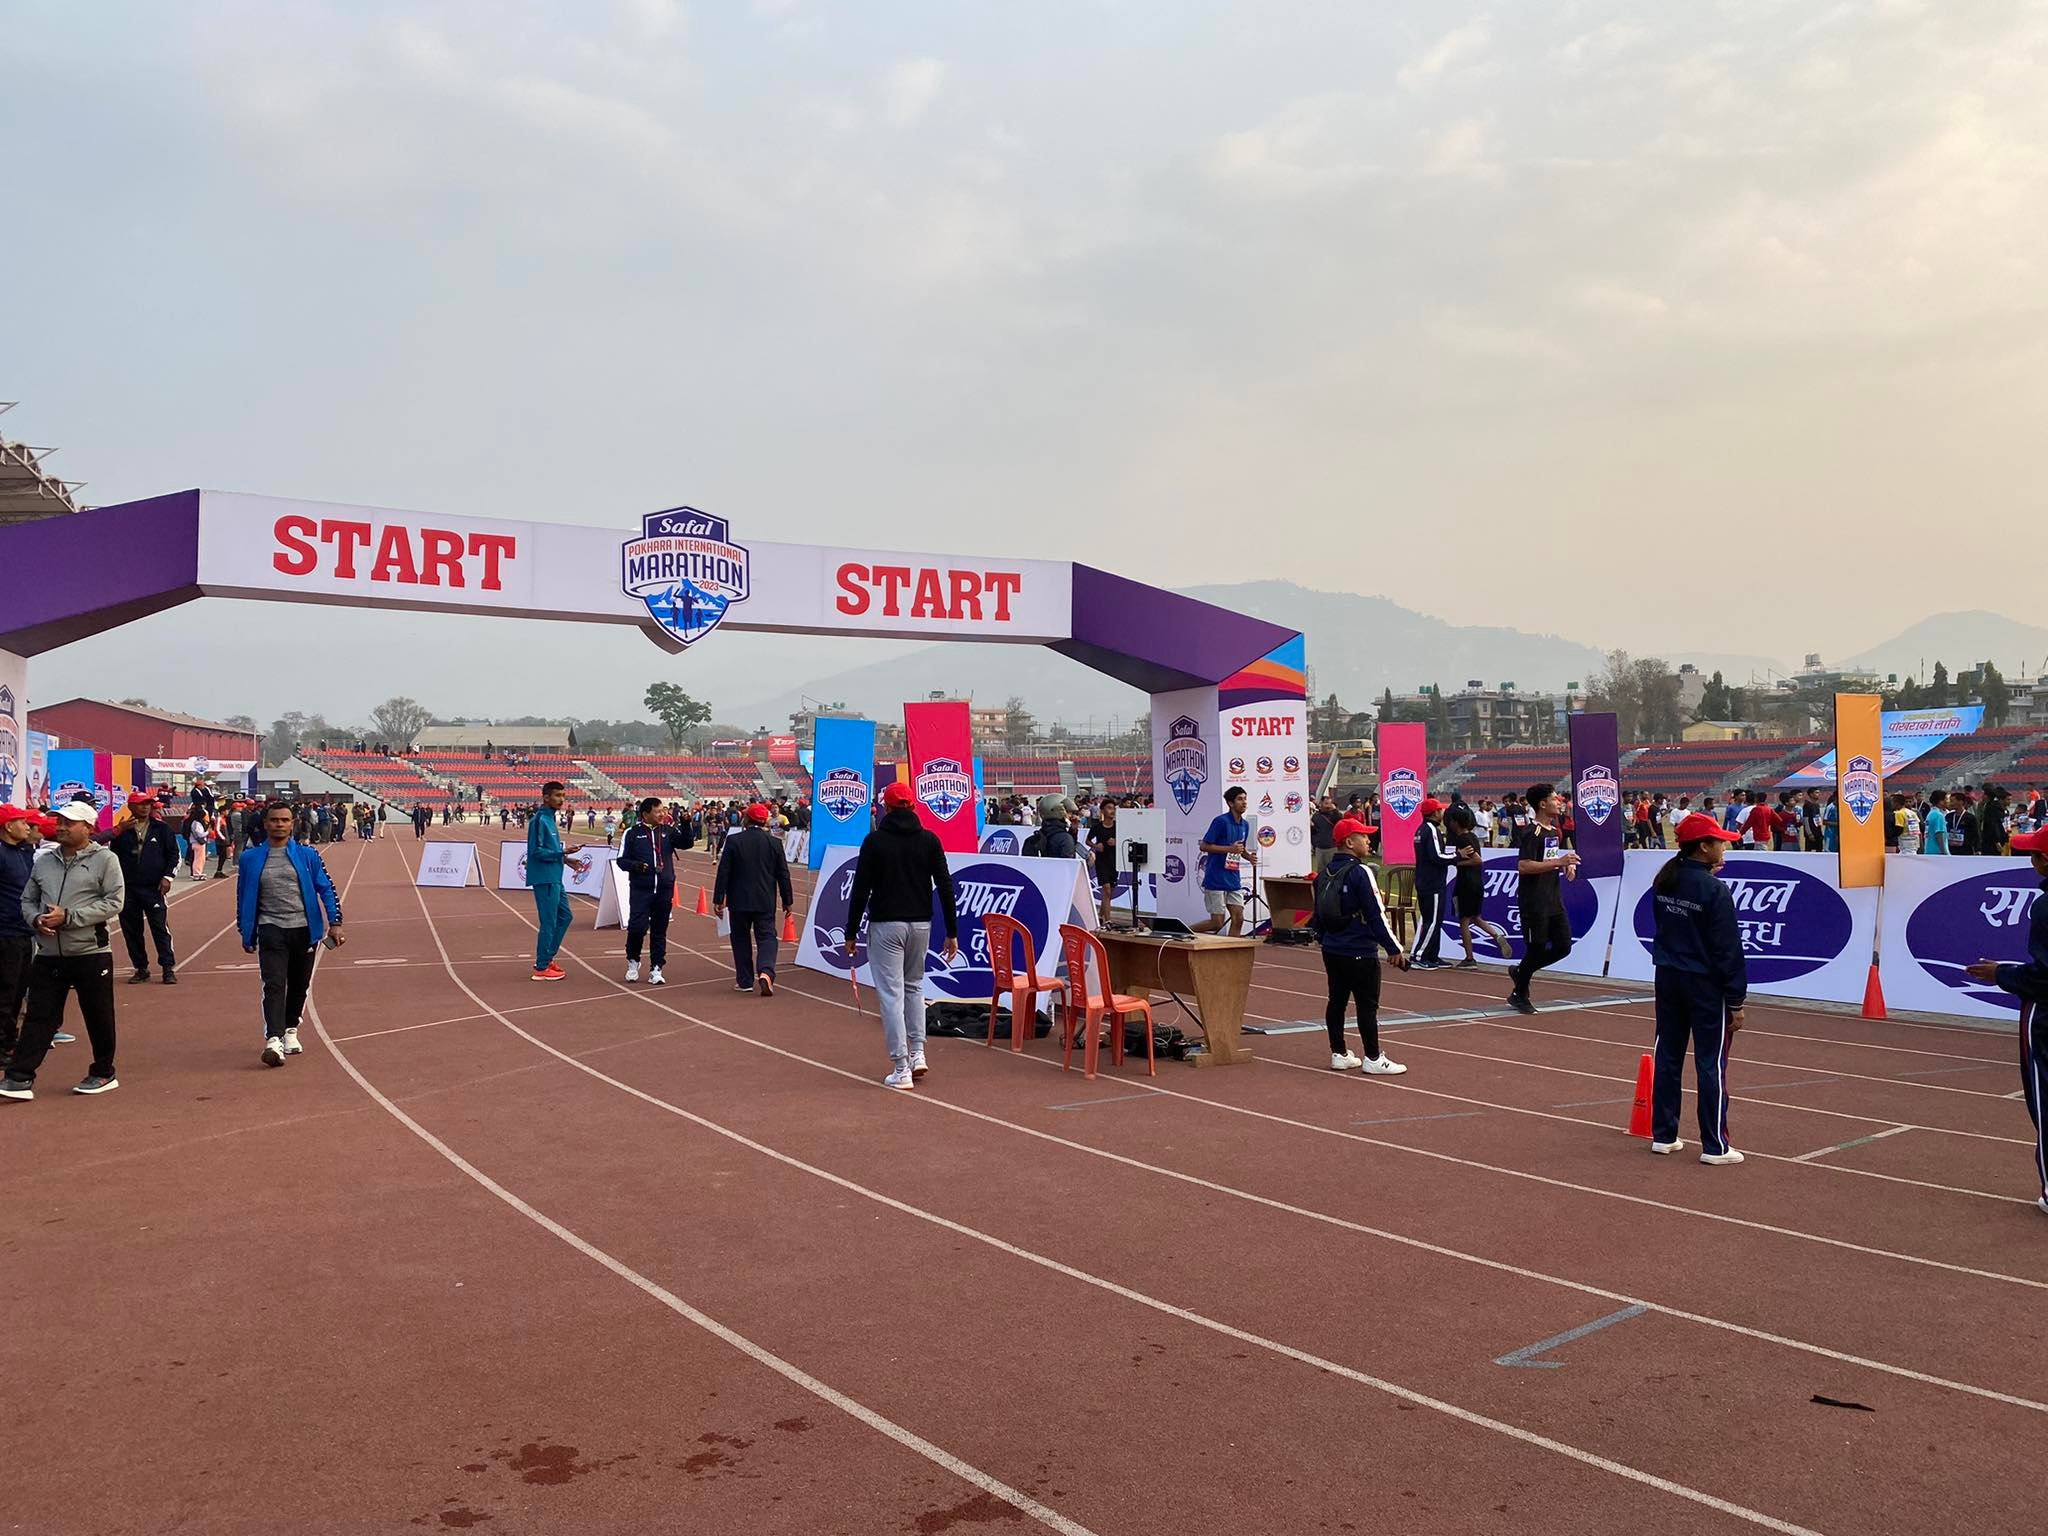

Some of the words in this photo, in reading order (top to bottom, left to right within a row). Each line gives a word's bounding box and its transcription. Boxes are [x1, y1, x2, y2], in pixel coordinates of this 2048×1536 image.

[659, 518, 714, 536] Safal
[273, 515, 516, 591] START
[628, 539, 673, 558] POKHARA
[674, 539, 743, 564] INTERNATIONAL
[629, 552, 743, 590] MARATHON
[699, 580, 720, 591] 2023
[836, 562, 1021, 622] START
[1174, 723, 1194, 737] Safal
[1231, 716, 1295, 737] START
[931, 764, 954, 772] Safal
[1165, 748, 1206, 774] MARATHON
[1853, 762, 1869, 770] Safal
[833, 772, 855, 780] Safal
[821, 785, 865, 801] MARATHON
[920, 779, 967, 796] MARATHON
[1386, 785, 1421, 798] MARATHON
[1580, 785, 1616, 801] MARATHON
[1844, 778, 1878, 796] MARATHON
